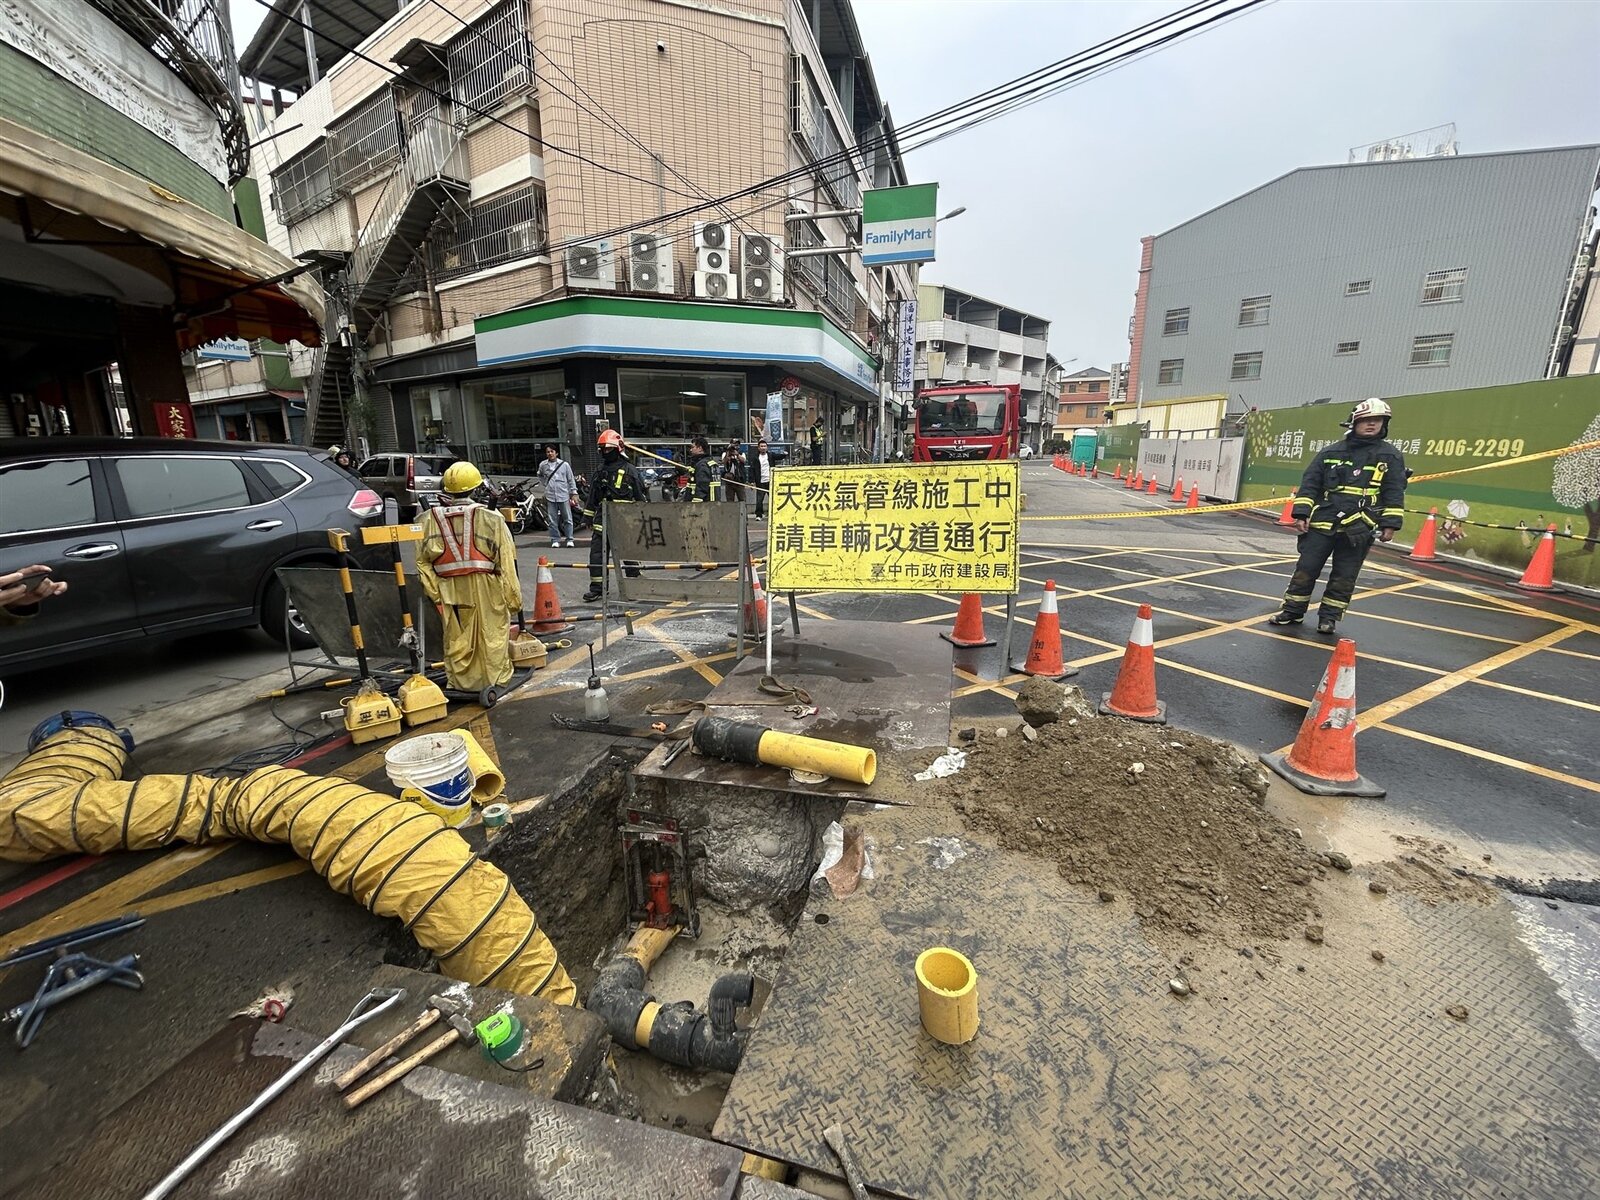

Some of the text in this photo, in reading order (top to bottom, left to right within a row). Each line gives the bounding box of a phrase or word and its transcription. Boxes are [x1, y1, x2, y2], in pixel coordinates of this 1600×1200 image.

[865, 228, 932, 245] FamilyMart
[1383, 438, 1421, 454] 境2房
[1425, 438, 1525, 457] 2406-2299
[776, 476, 1011, 511] 天然氣管線施工中
[775, 521, 1011, 553] 請車輛改道通行
[870, 562, 1009, 578] 臺中市政府建設局
